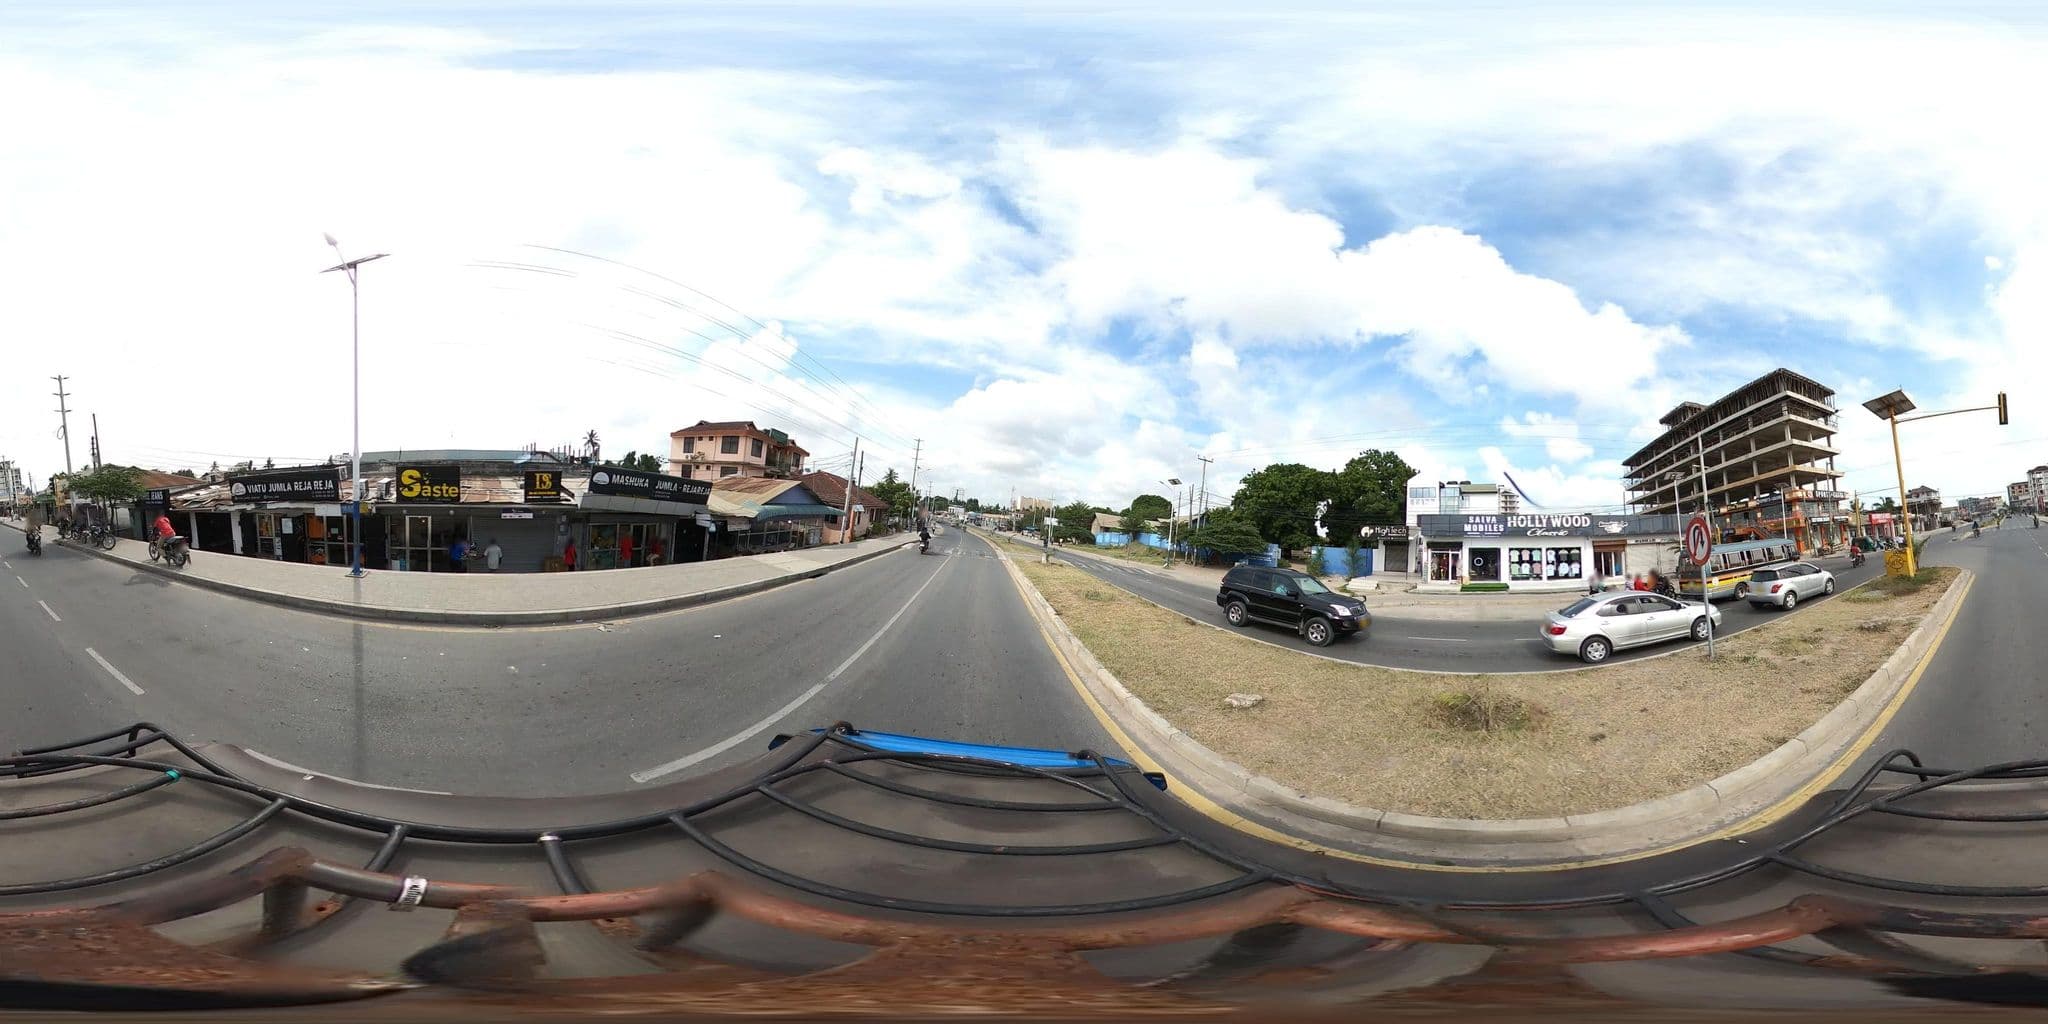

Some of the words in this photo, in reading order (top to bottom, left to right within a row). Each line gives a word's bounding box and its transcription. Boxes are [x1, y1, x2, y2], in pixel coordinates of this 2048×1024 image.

[246, 484, 267, 494] VIATU
[268, 482, 292, 492] JUMLA
[293, 481, 312, 491] REJA
[313, 479, 334, 490] REJA
[400, 469, 459, 498] Saste
[611, 474, 649, 489] MASHUKA
[655, 480, 678, 492] JUMLA
[1463, 524, 1504, 532] MOBILES
[1507, 515, 1591, 528] HOLLYWOOD
